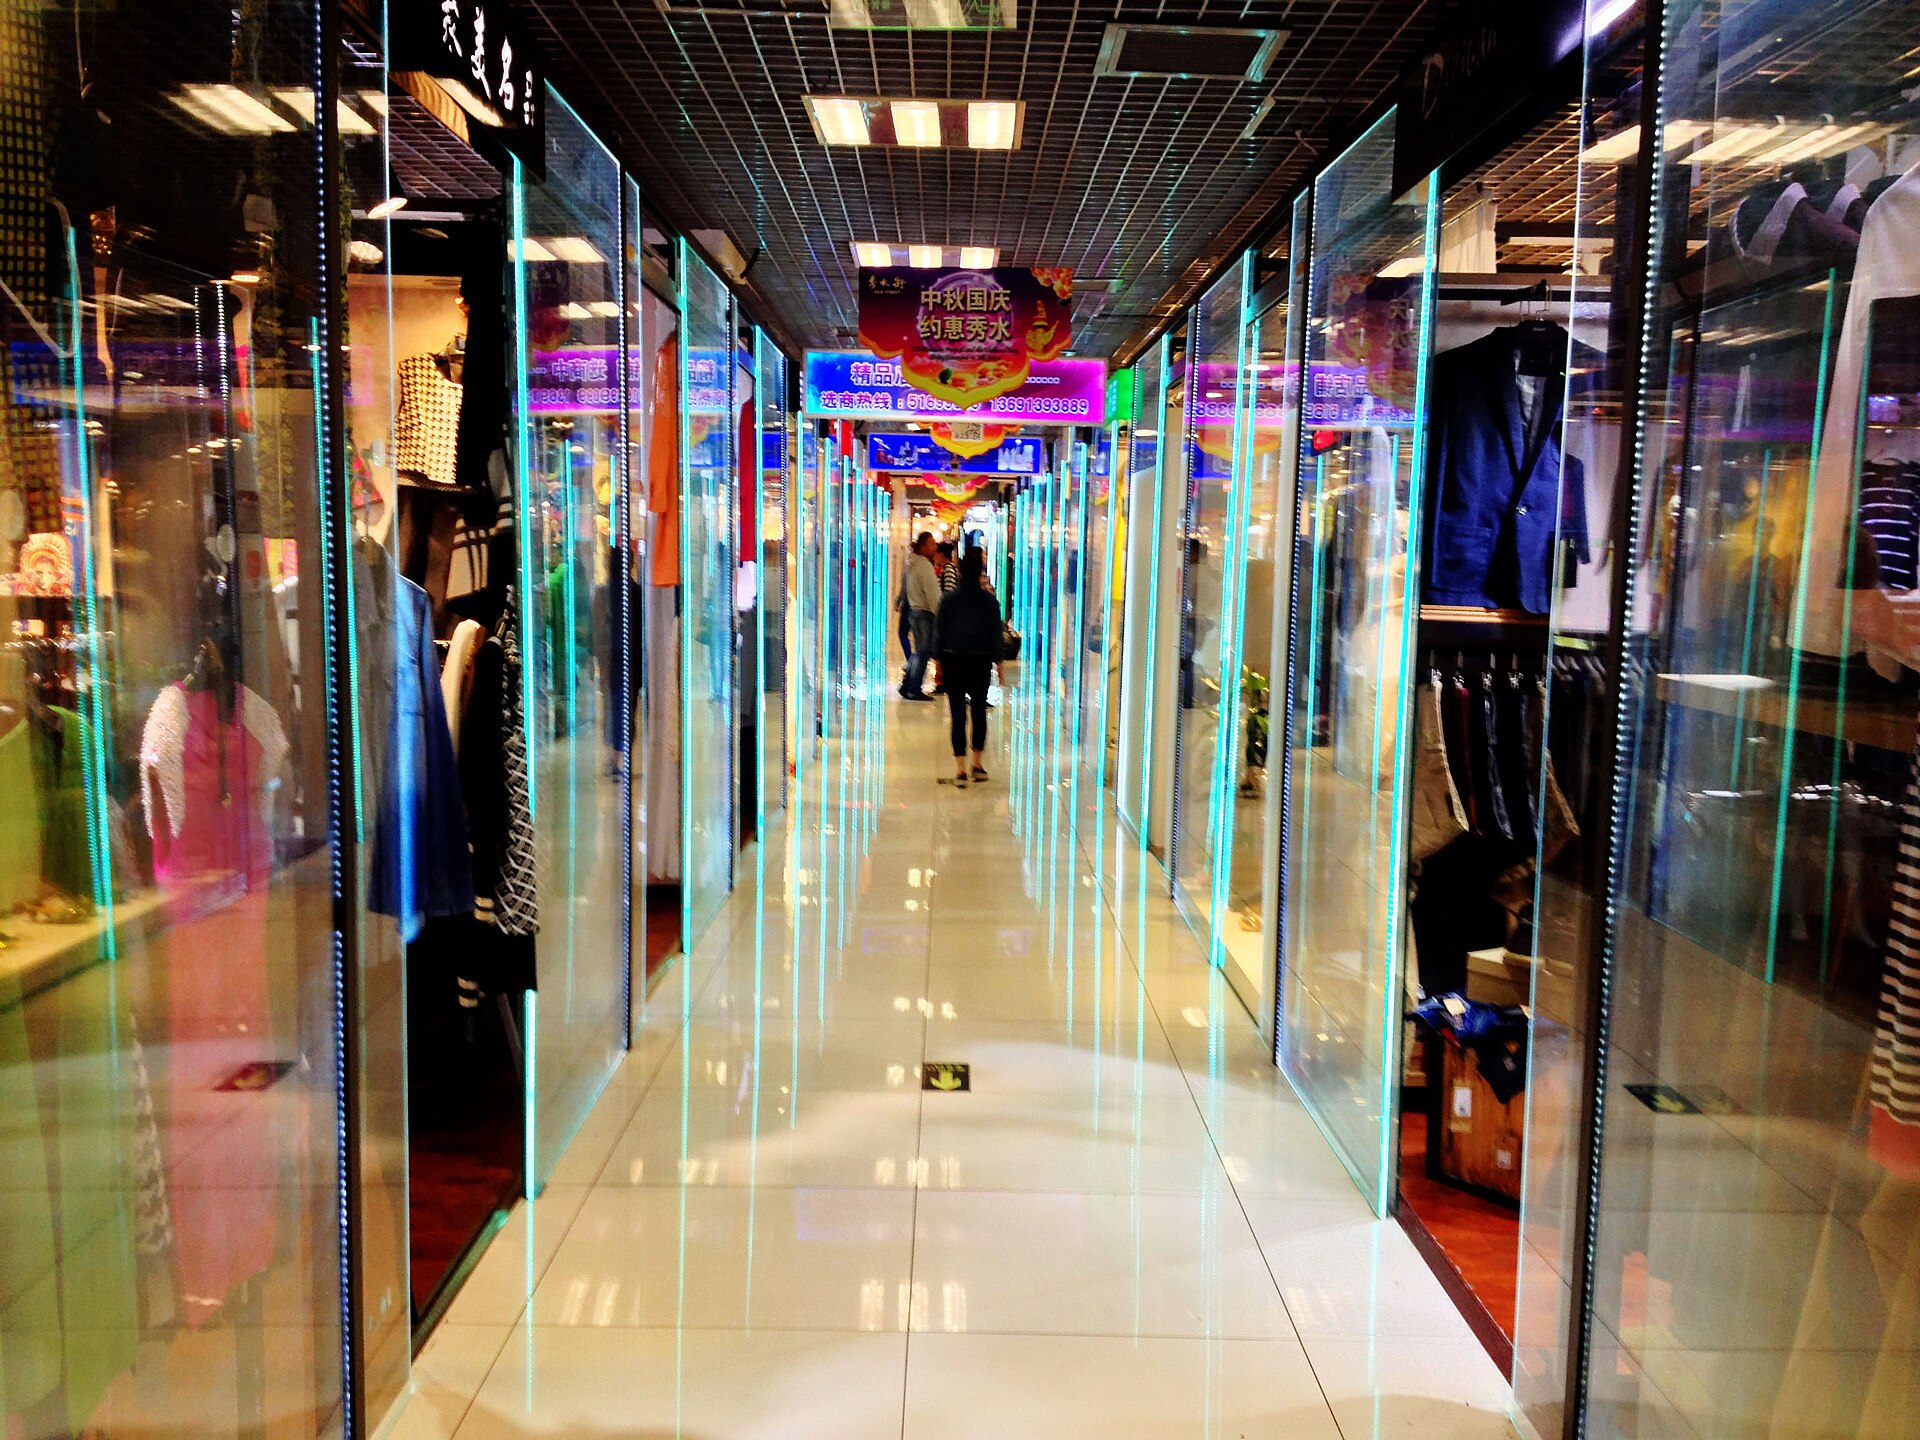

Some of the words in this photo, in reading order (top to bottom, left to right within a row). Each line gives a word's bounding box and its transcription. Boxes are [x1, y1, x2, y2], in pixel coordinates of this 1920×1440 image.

[920, 287, 1011, 313] 中秋国庆
[919, 316, 1011, 341] 约惠秀水
[990, 397, 1089, 414] 13691393889
